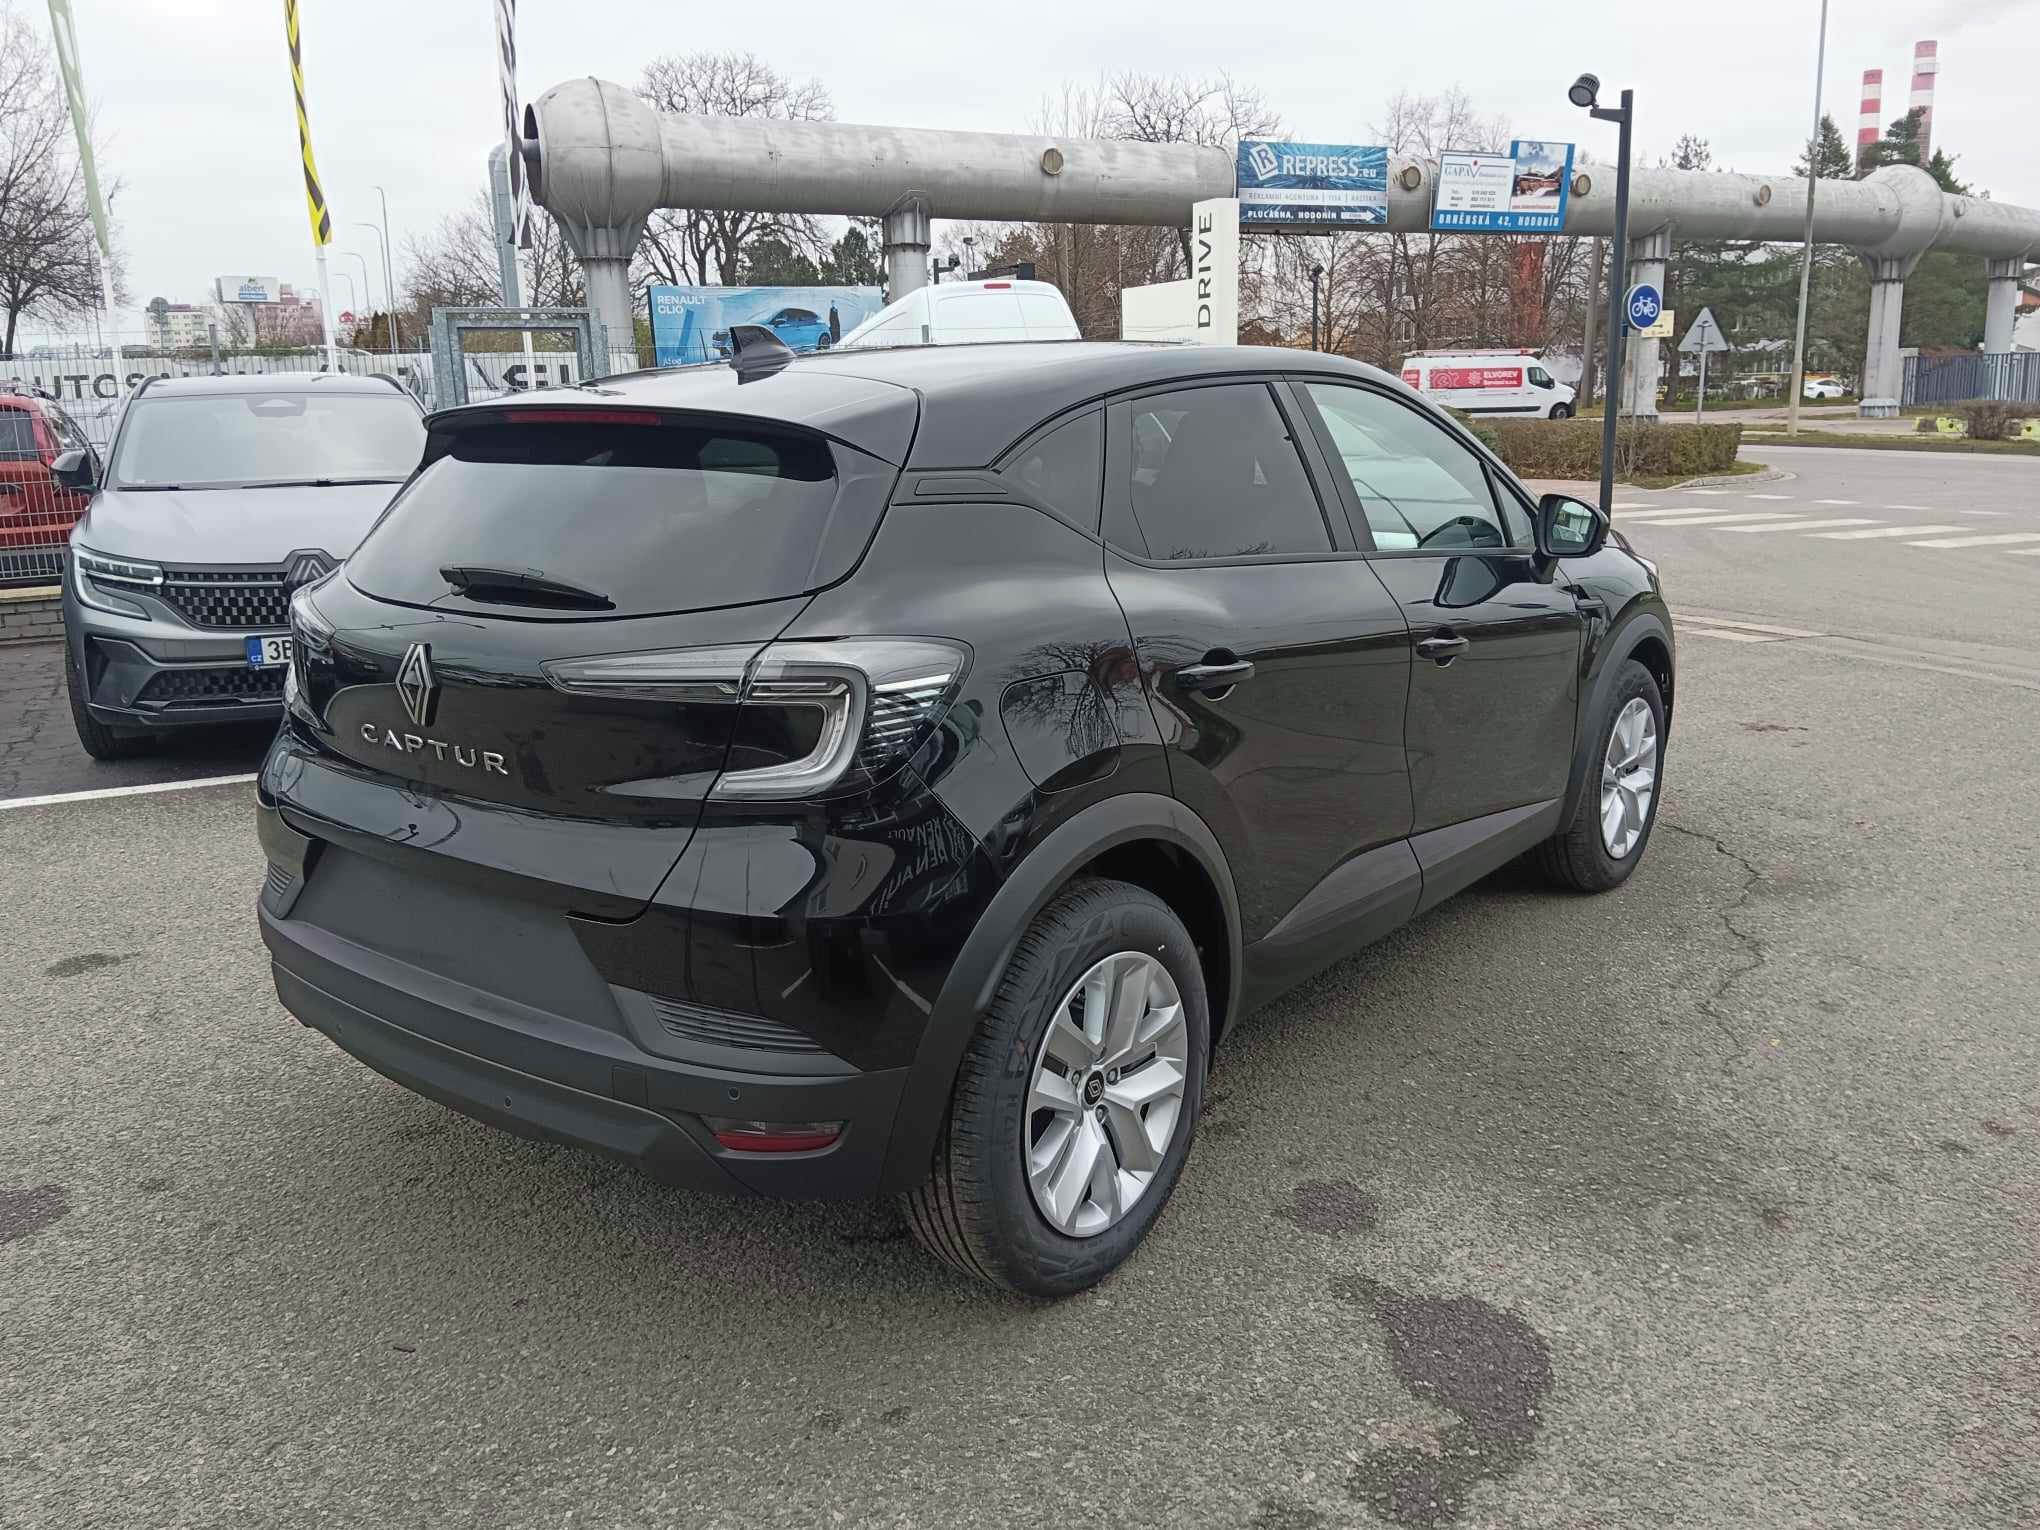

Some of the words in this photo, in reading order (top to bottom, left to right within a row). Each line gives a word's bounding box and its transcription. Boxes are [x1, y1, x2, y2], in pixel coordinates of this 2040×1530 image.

[1197, 212, 1212, 328] DRIVE
[657, 295, 705, 305] RENAULT
[657, 305, 684, 314] CLIO
[360, 722, 509, 776] CAPTUR
